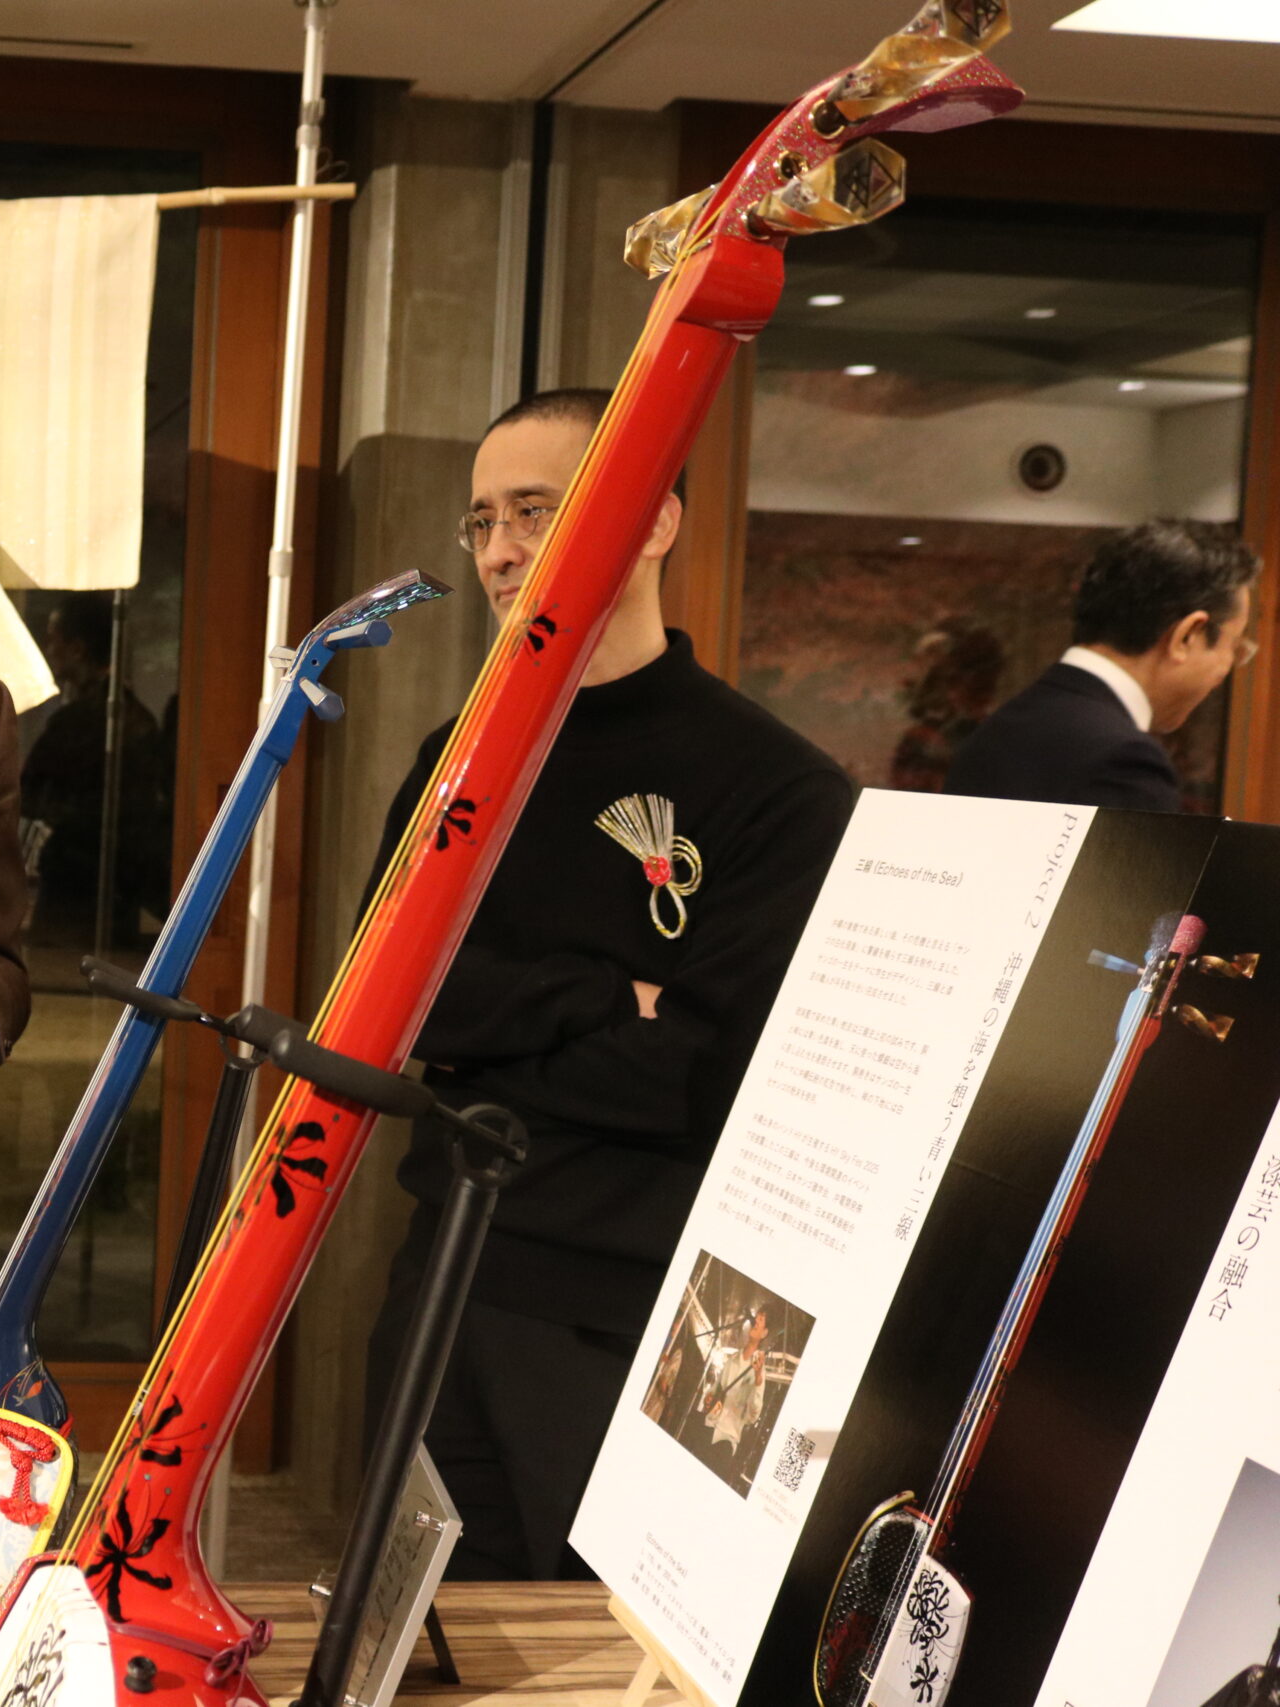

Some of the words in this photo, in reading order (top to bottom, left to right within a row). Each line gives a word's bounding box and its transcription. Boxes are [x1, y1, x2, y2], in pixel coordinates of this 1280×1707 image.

[910, 866, 923, 880] of
[921, 869, 938, 883] the
[1034, 812, 1078, 903] project
[1024, 910, 1041, 929] 2
[894, 952, 1023, 1241] 沖縄の海を想う青い三線
